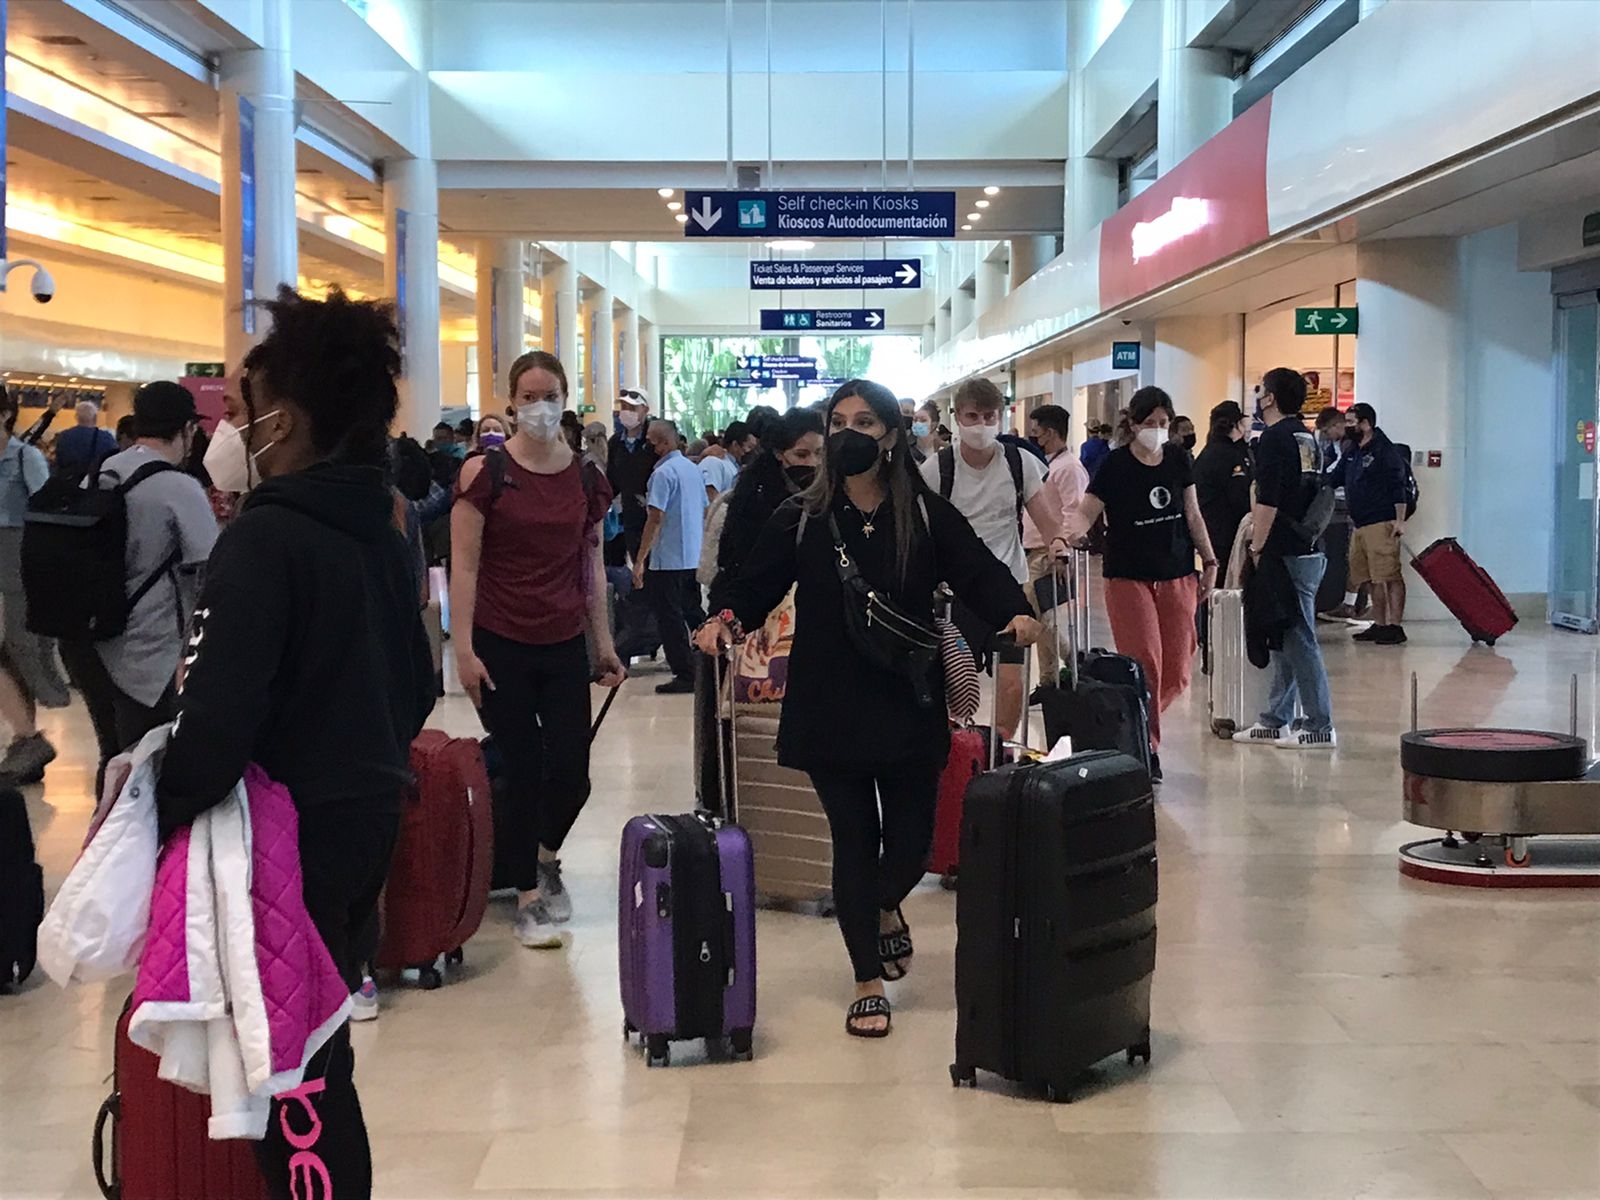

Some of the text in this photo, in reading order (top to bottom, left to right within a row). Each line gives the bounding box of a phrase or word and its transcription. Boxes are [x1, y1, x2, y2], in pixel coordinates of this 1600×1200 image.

[778, 195, 920, 211] Self check-in Kiosks
[778, 212, 948, 229] Kioscos Autodocumentación
[753, 263, 865, 275] Ticket Sales & Passenger Services
[753, 275, 894, 286] Venta de boletos y servicios al pasajero
[815, 310, 852, 319] Restrooms
[815, 319, 852, 328] Sanitarios
[1117, 351, 1136, 361] ATM
